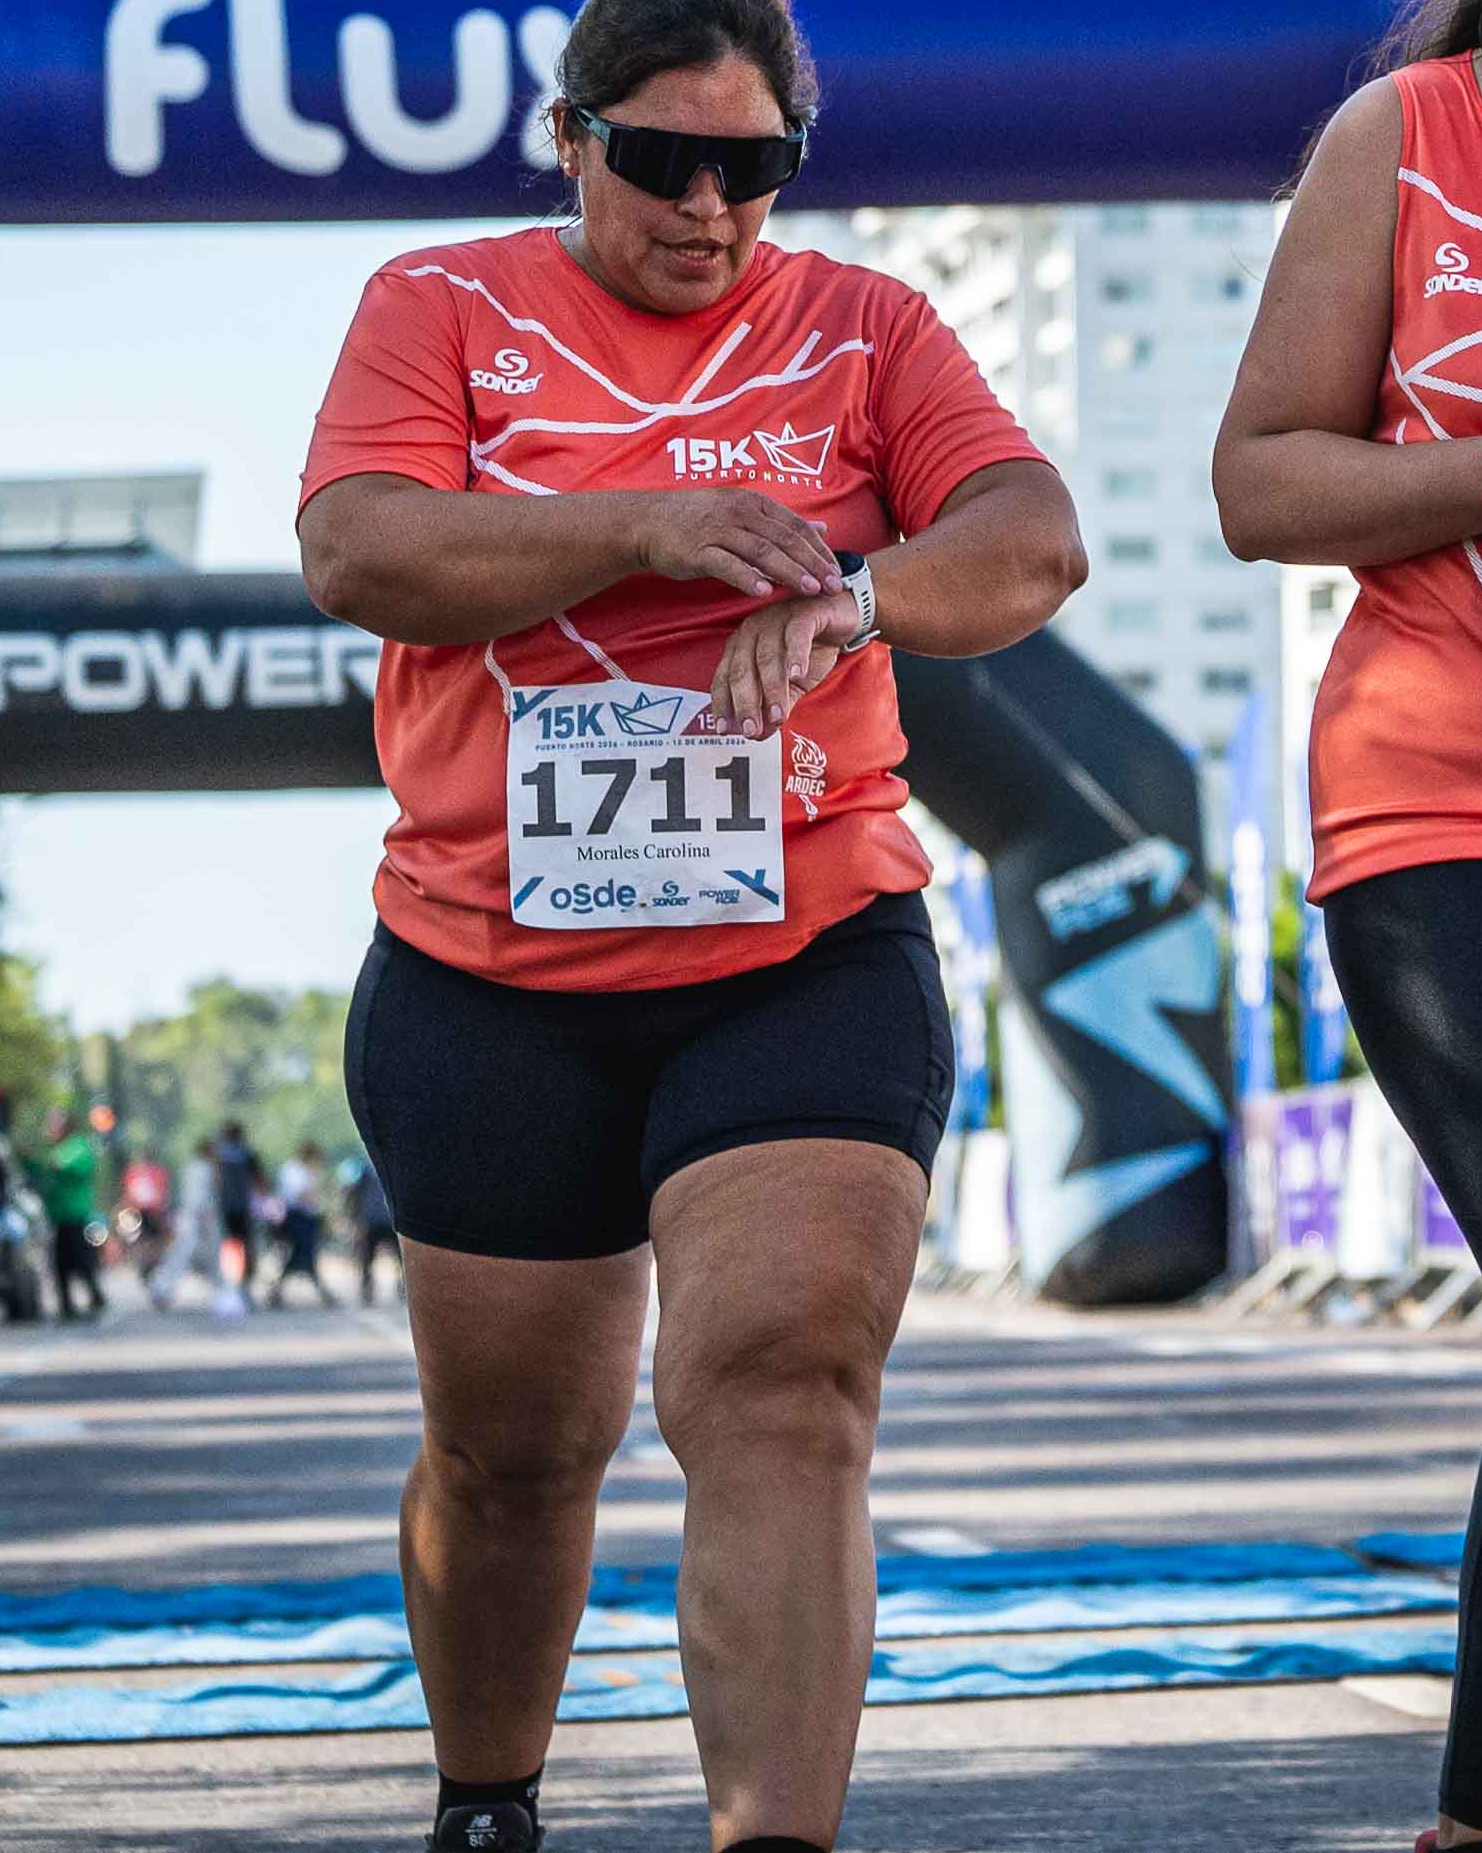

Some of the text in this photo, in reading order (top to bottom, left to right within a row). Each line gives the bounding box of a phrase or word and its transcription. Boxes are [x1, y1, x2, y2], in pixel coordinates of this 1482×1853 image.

[667, 435, 757, 474] 15K
[763, 471, 822, 490] NORTE
[537, 702, 606, 740] 15K
[626, 738, 664, 748] ROSARIO
[698, 736, 723, 746] ABRIL
[521, 756, 767, 838] 1711
[785, 775, 826, 797] ARDEC
[577, 843, 711, 861] Morales Carolina
[550, 878, 637, 914] osde
